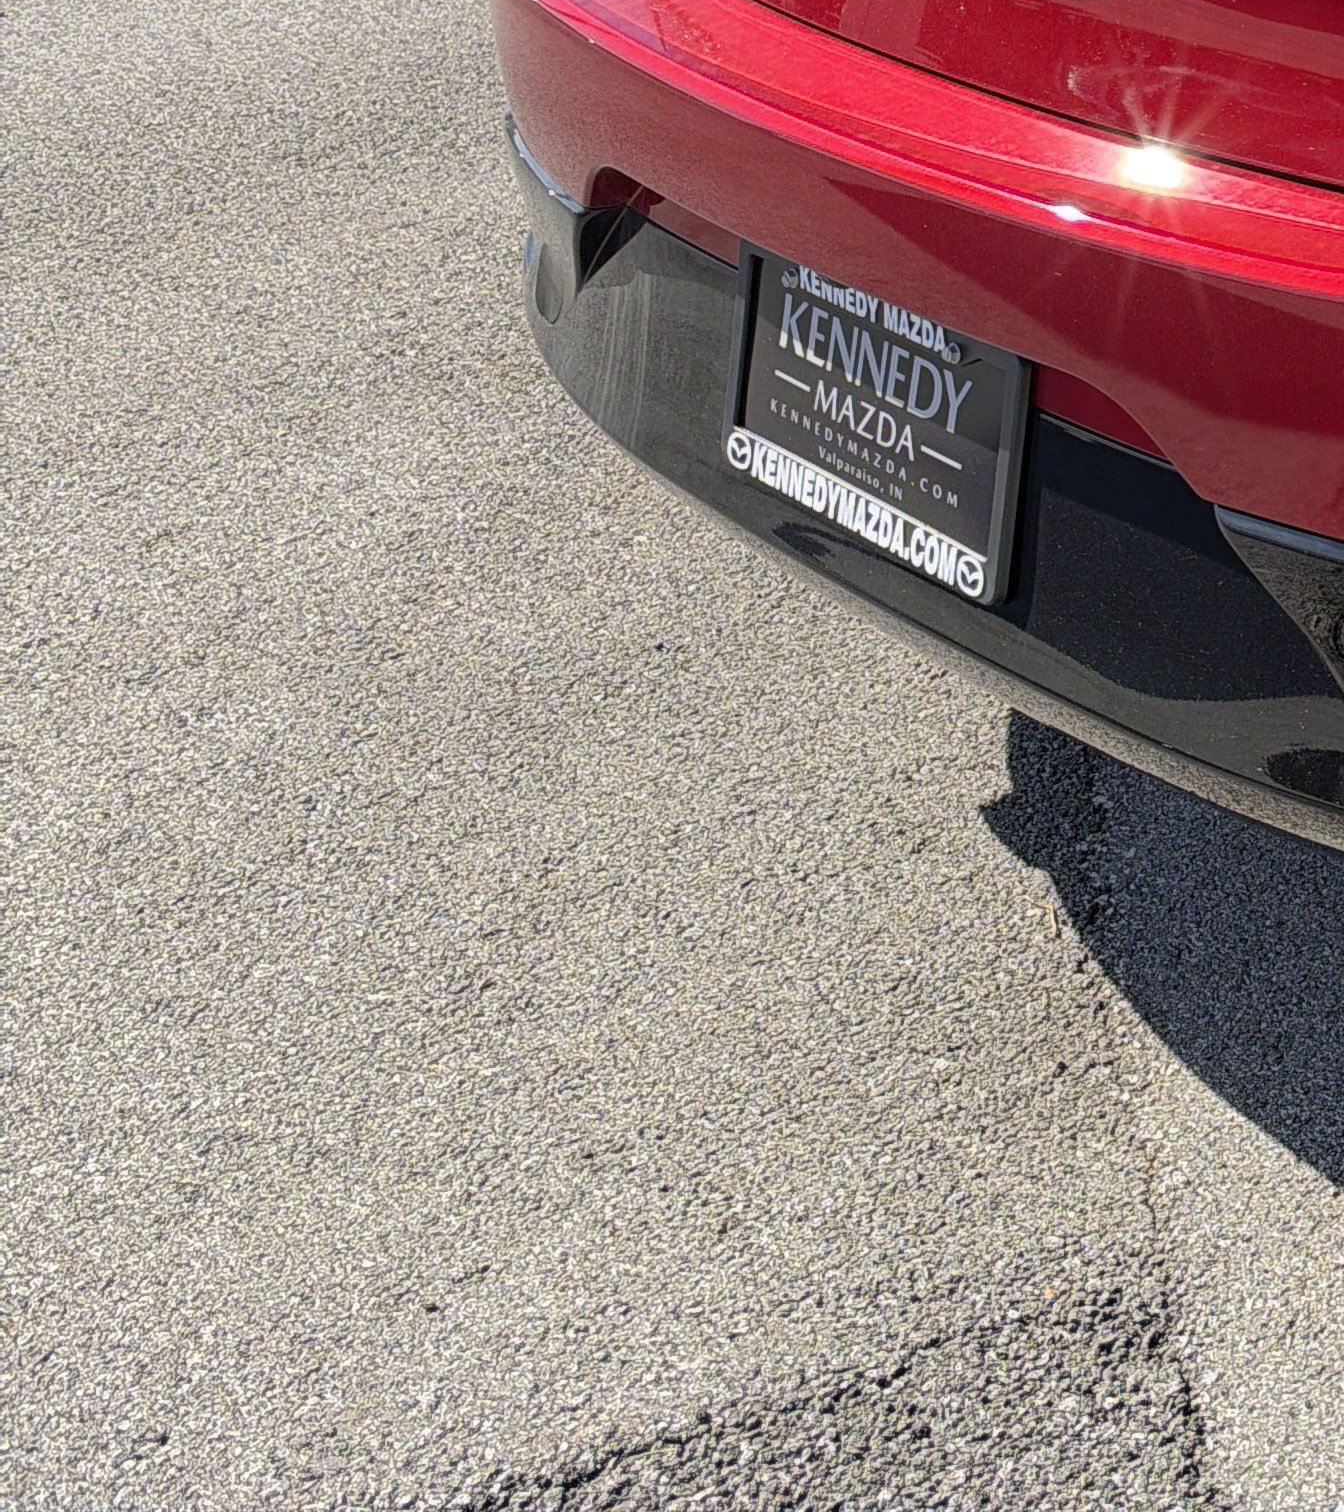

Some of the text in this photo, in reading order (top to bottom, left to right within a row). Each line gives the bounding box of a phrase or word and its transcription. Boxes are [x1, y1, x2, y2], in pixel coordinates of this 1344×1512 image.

[799, 264, 946, 354] KENNEDY MAZDA
[778, 292, 973, 435] KENNEDY
[769, 397, 959, 509] KENNEDYMAZDA.COM
[813, 378, 916, 462] MAZDA
[750, 443, 957, 588] KENNEDYMAZDA.COM
[817, 444, 904, 502] Valparaiso, IN
